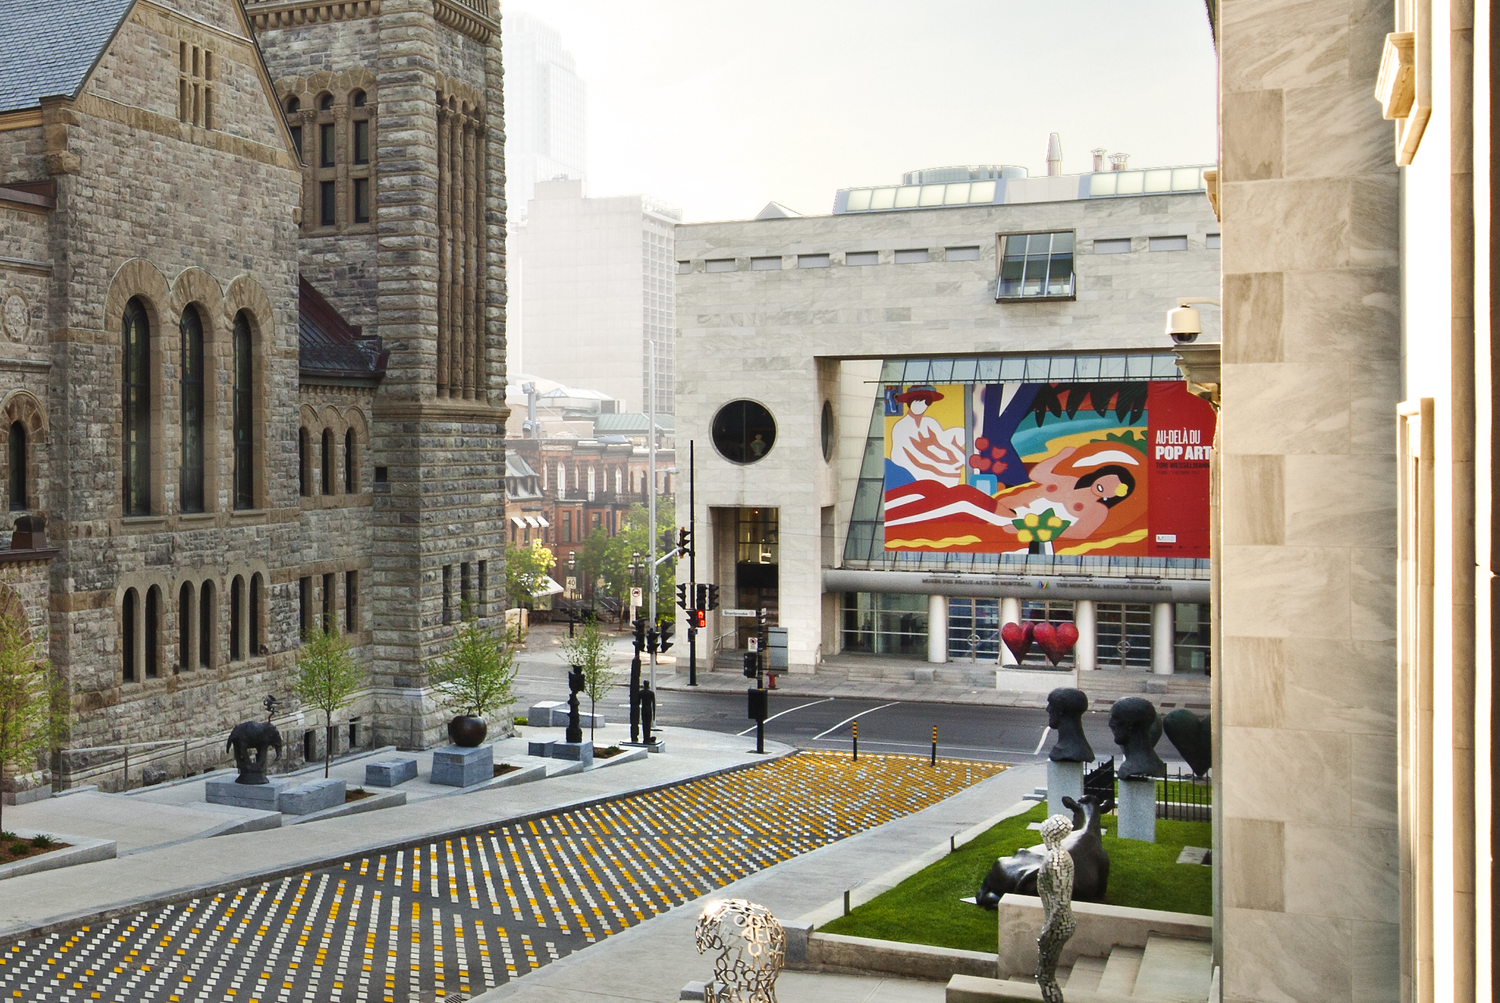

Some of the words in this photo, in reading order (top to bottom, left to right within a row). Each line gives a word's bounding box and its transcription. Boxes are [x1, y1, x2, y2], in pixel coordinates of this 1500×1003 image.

[1156, 427, 1188, 444] AU-DELÀ
[1190, 430, 1200, 444] DU
[1155, 446, 1183, 460] POP
[1185, 446, 1212, 460] ART
